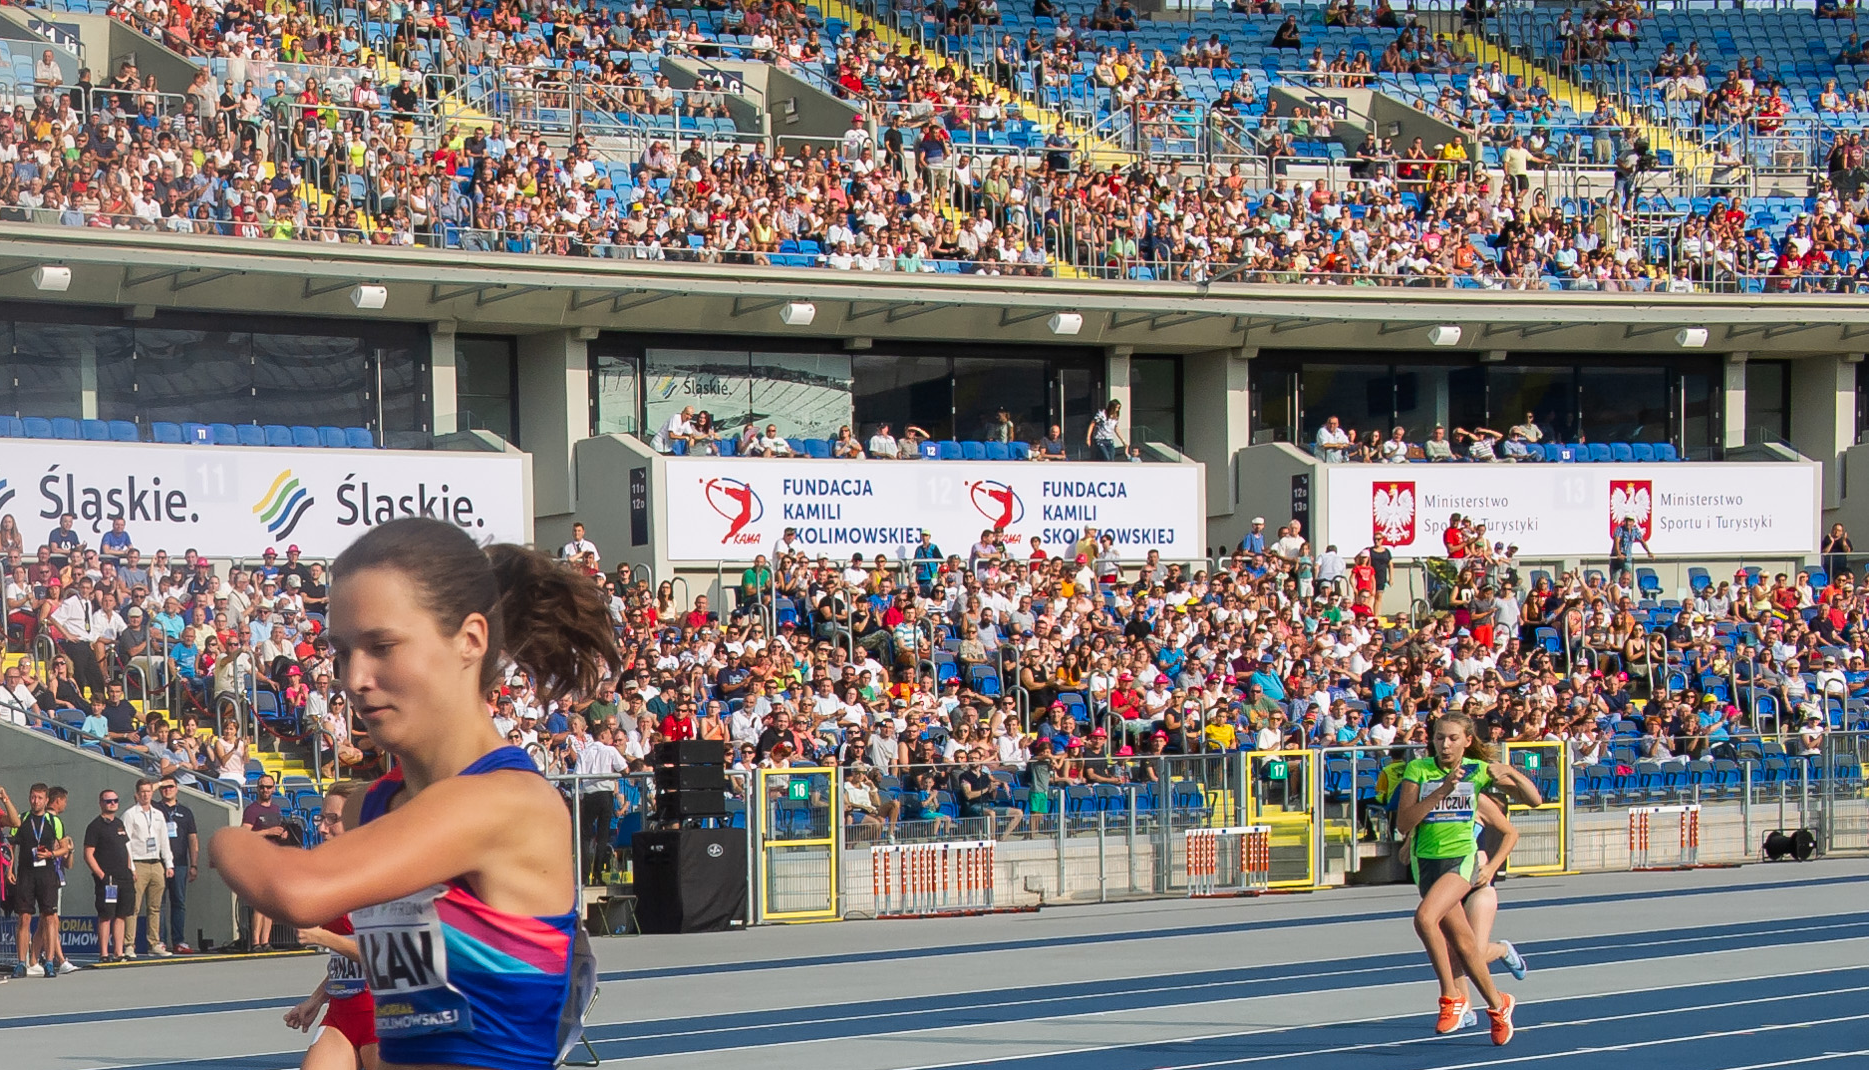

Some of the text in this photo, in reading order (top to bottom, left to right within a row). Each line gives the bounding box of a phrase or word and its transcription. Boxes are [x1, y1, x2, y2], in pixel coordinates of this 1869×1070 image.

[783, 479, 873, 497] FUNDACJA
[1042, 481, 1127, 498] FUNDACJA
[39, 464, 199, 533] Śląskie.
[1424, 495, 1509, 508] Ministerstwo
[1660, 493, 1743, 506] Ministerstwo
[783, 503, 841, 521] KAMILI
[1042, 505, 1097, 521] KAMILI
[1660, 515, 1772, 532] Sportu i Turystyki
[795, 527, 923, 544] KOLIMOWSKIEJ
[1274, 764, 1285, 777] 17
[793, 783, 805, 797] 16
